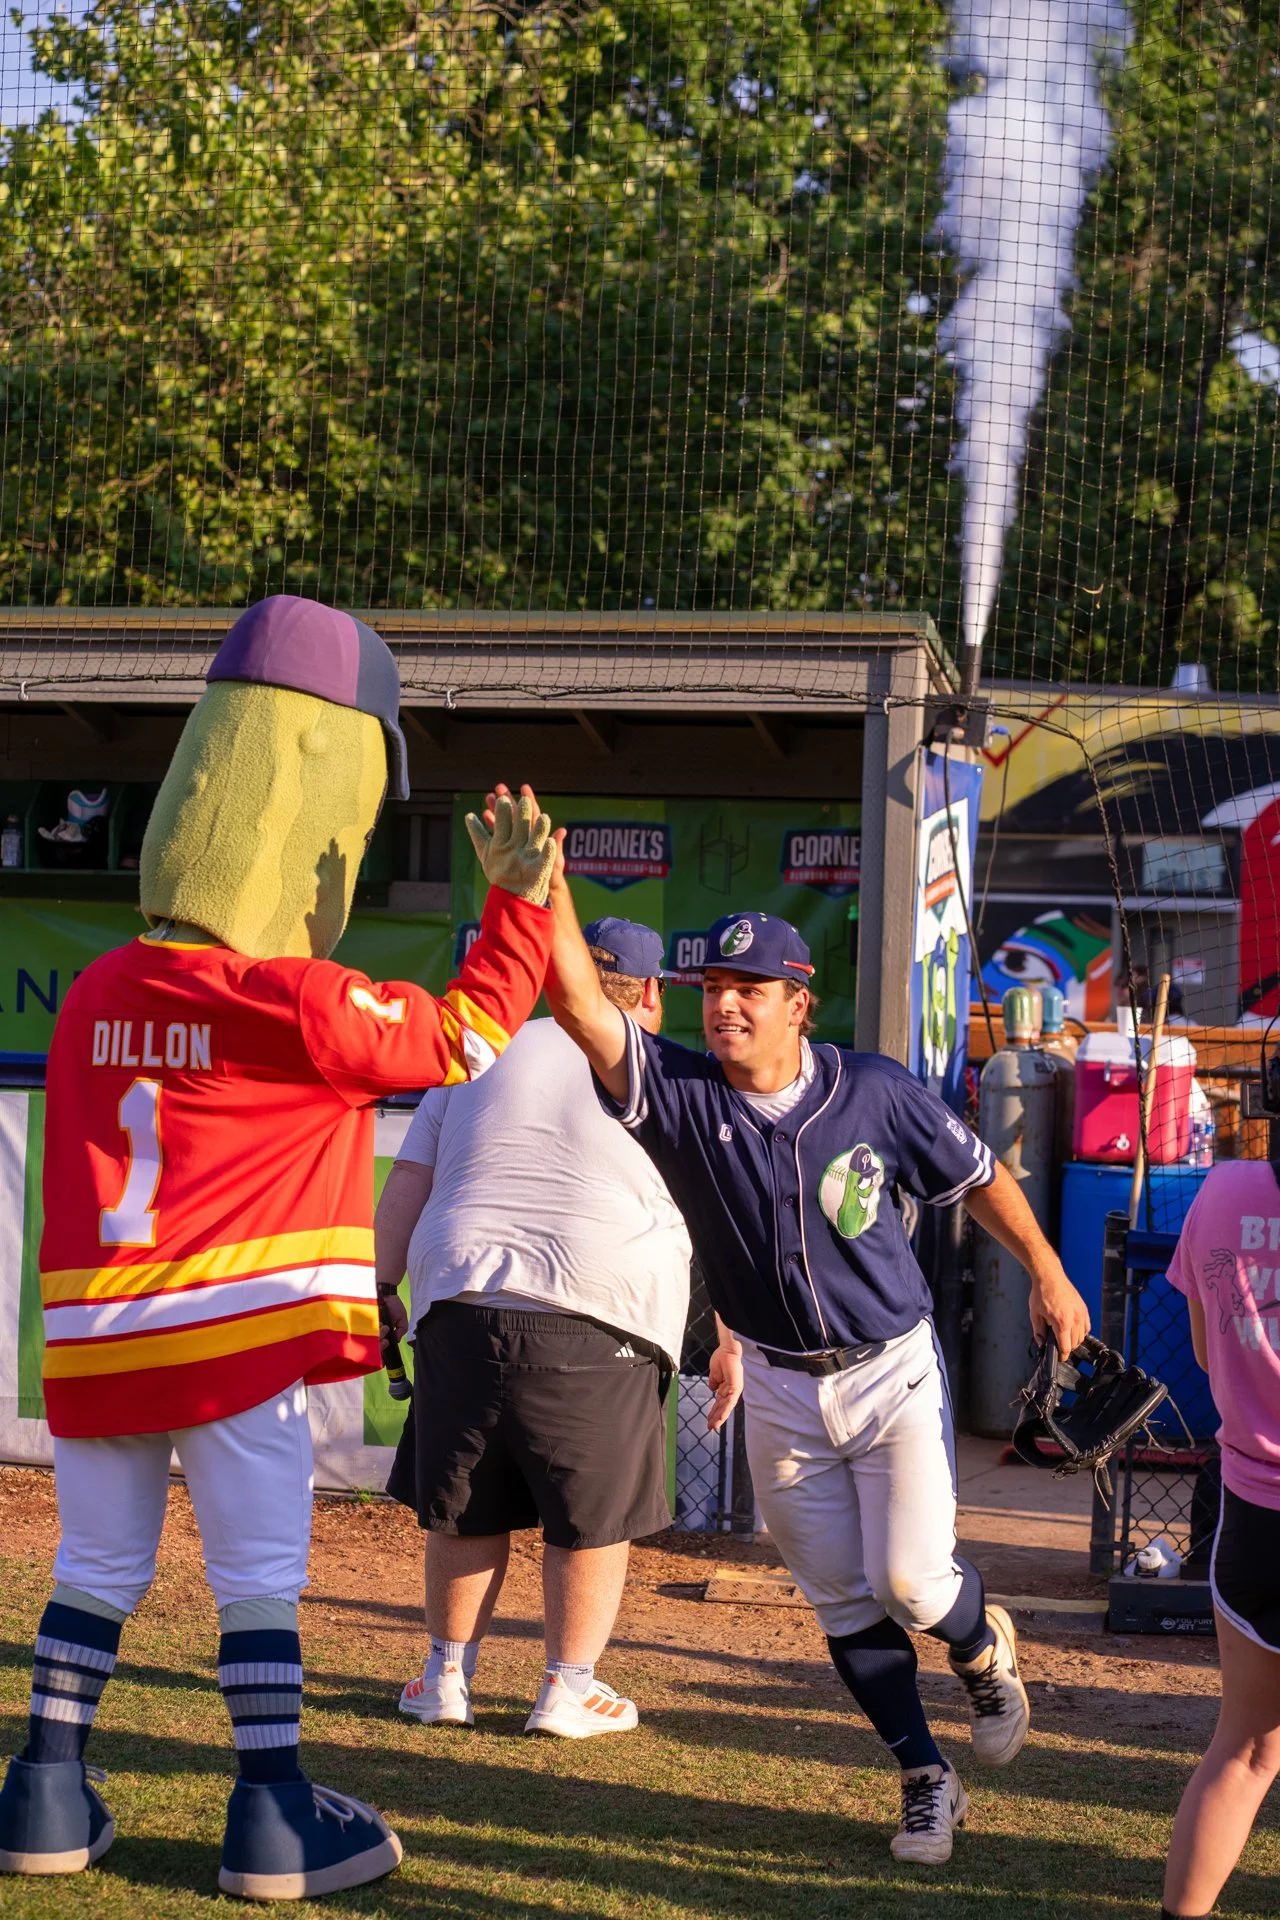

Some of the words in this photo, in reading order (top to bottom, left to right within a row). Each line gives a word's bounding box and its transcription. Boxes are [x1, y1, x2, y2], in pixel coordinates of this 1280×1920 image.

[570, 828, 664, 861] CORNEL'S
[790, 835, 861, 868] CORNE
[349, 985, 407, 1024] 1
[92, 1020, 212, 1071] DILLON
[99, 1077, 163, 1248] 1
